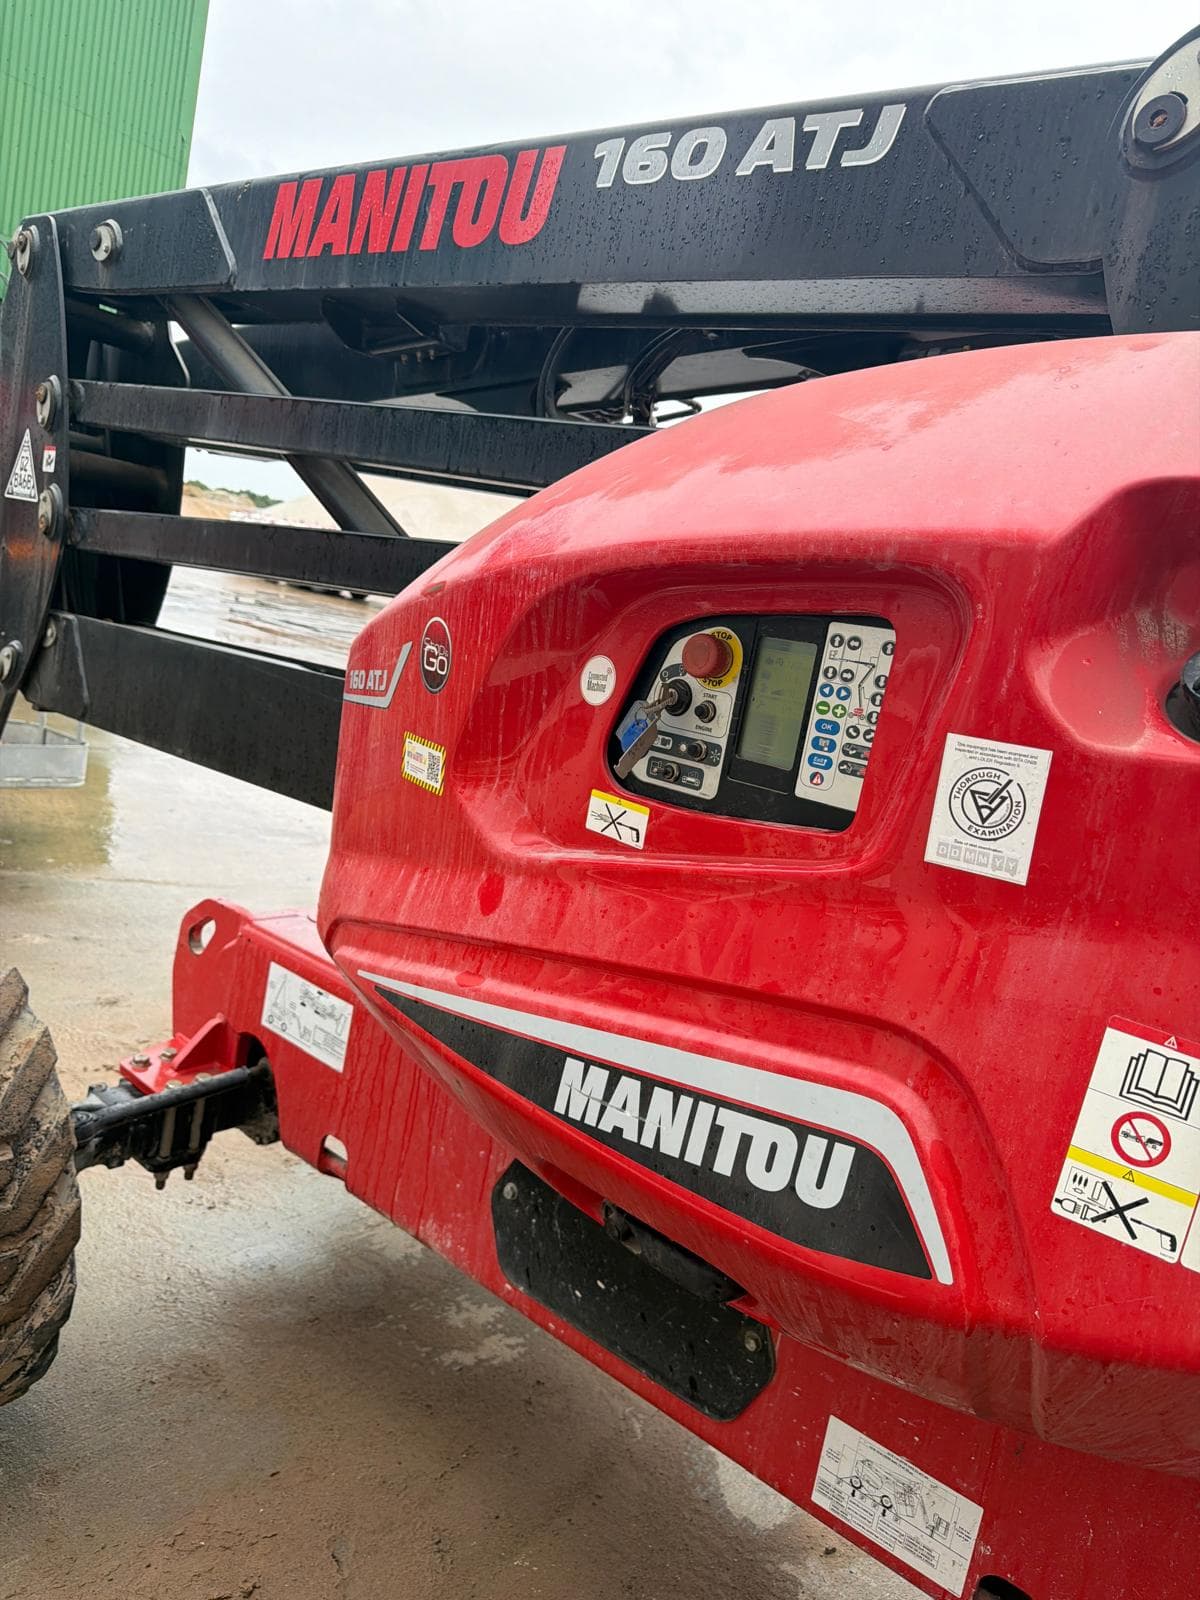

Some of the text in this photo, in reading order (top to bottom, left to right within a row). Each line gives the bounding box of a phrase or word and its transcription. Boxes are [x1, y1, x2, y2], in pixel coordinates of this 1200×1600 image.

[263, 102, 907, 260] MANITOU 160 ATJ
[711, 631, 733, 641] STOP
[350, 669, 388, 692] 160 ATJ
[702, 676, 724, 687] STOP
[703, 692, 718, 700] START
[695, 724, 713, 733] ENGINE
[821, 723, 833, 731] OK
[954, 771, 1002, 800] THOROUGH
[967, 800, 1022, 837] EXAMINATION
[553, 1056, 857, 1209] MANITOU
